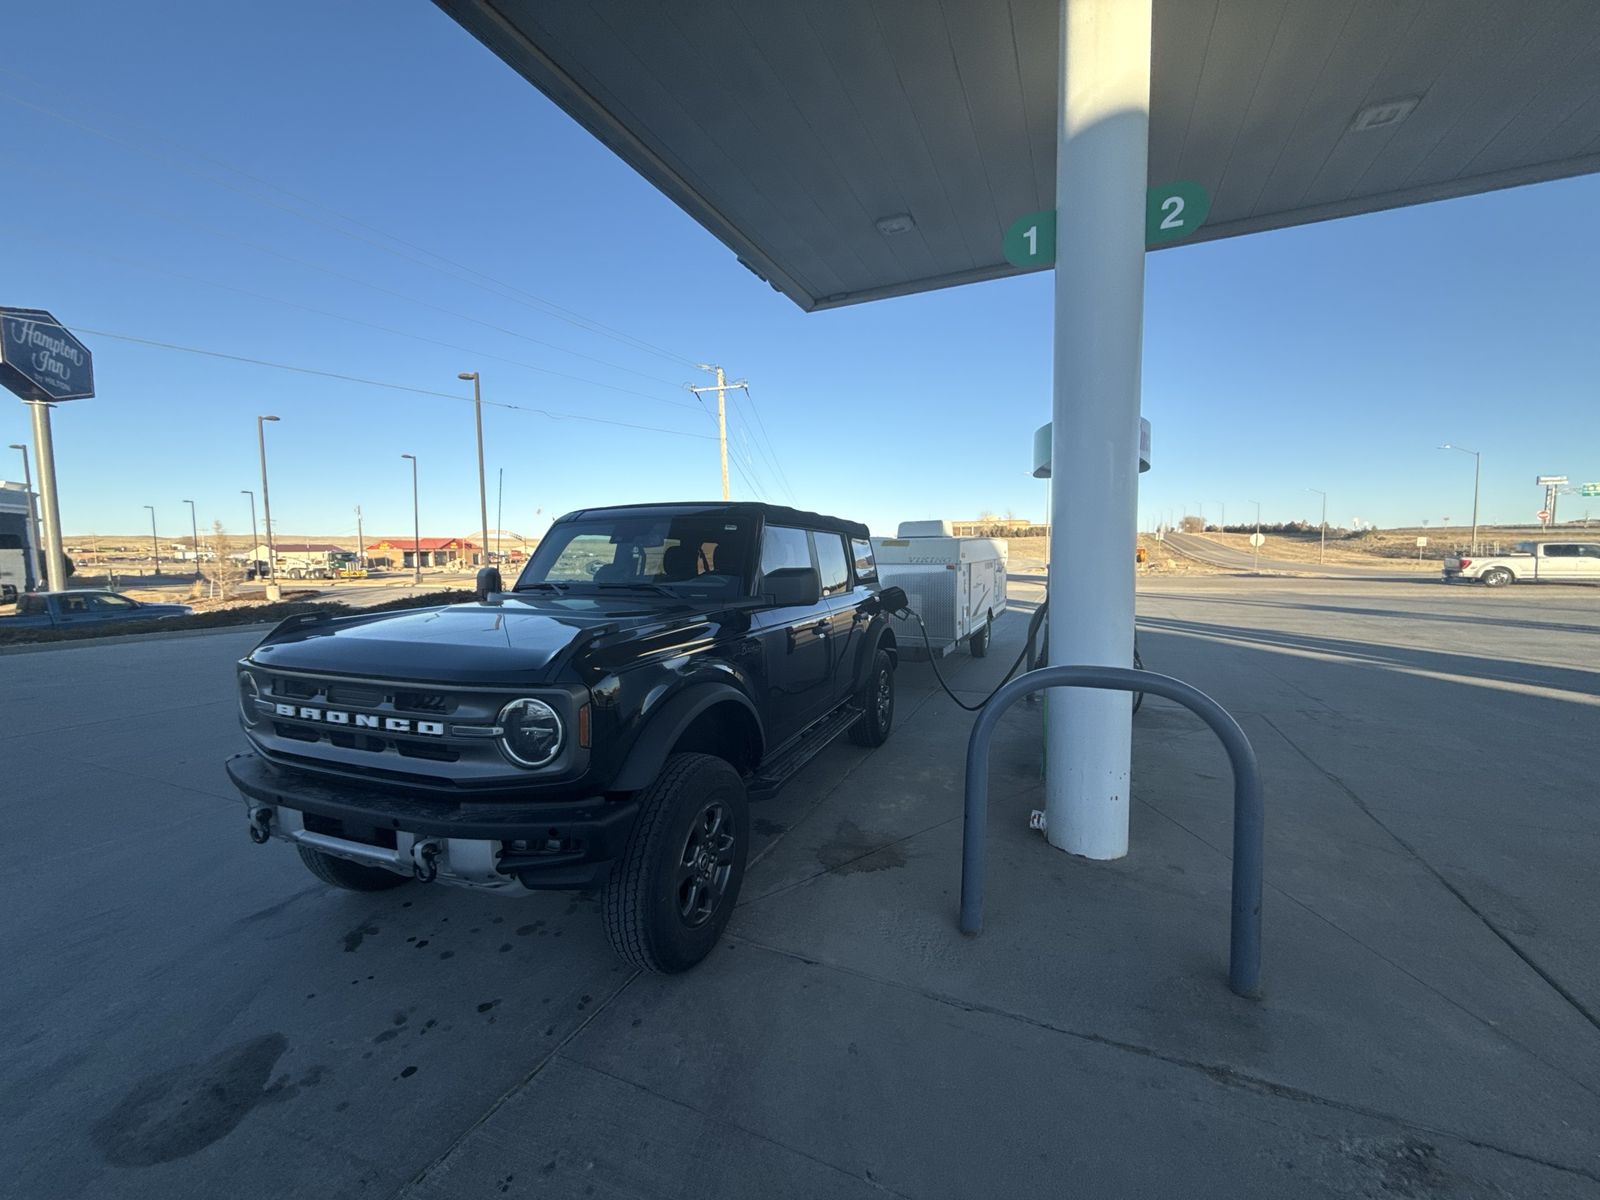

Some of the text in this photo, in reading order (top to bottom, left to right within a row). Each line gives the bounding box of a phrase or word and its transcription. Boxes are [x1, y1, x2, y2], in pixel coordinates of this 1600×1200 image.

[1160, 196, 1185, 230] 2
[1023, 226, 1037, 256] 1
[11, 321, 83, 367] Hampton
[31, 351, 70, 380] Inn
[276, 703, 444, 736] BRONCO
